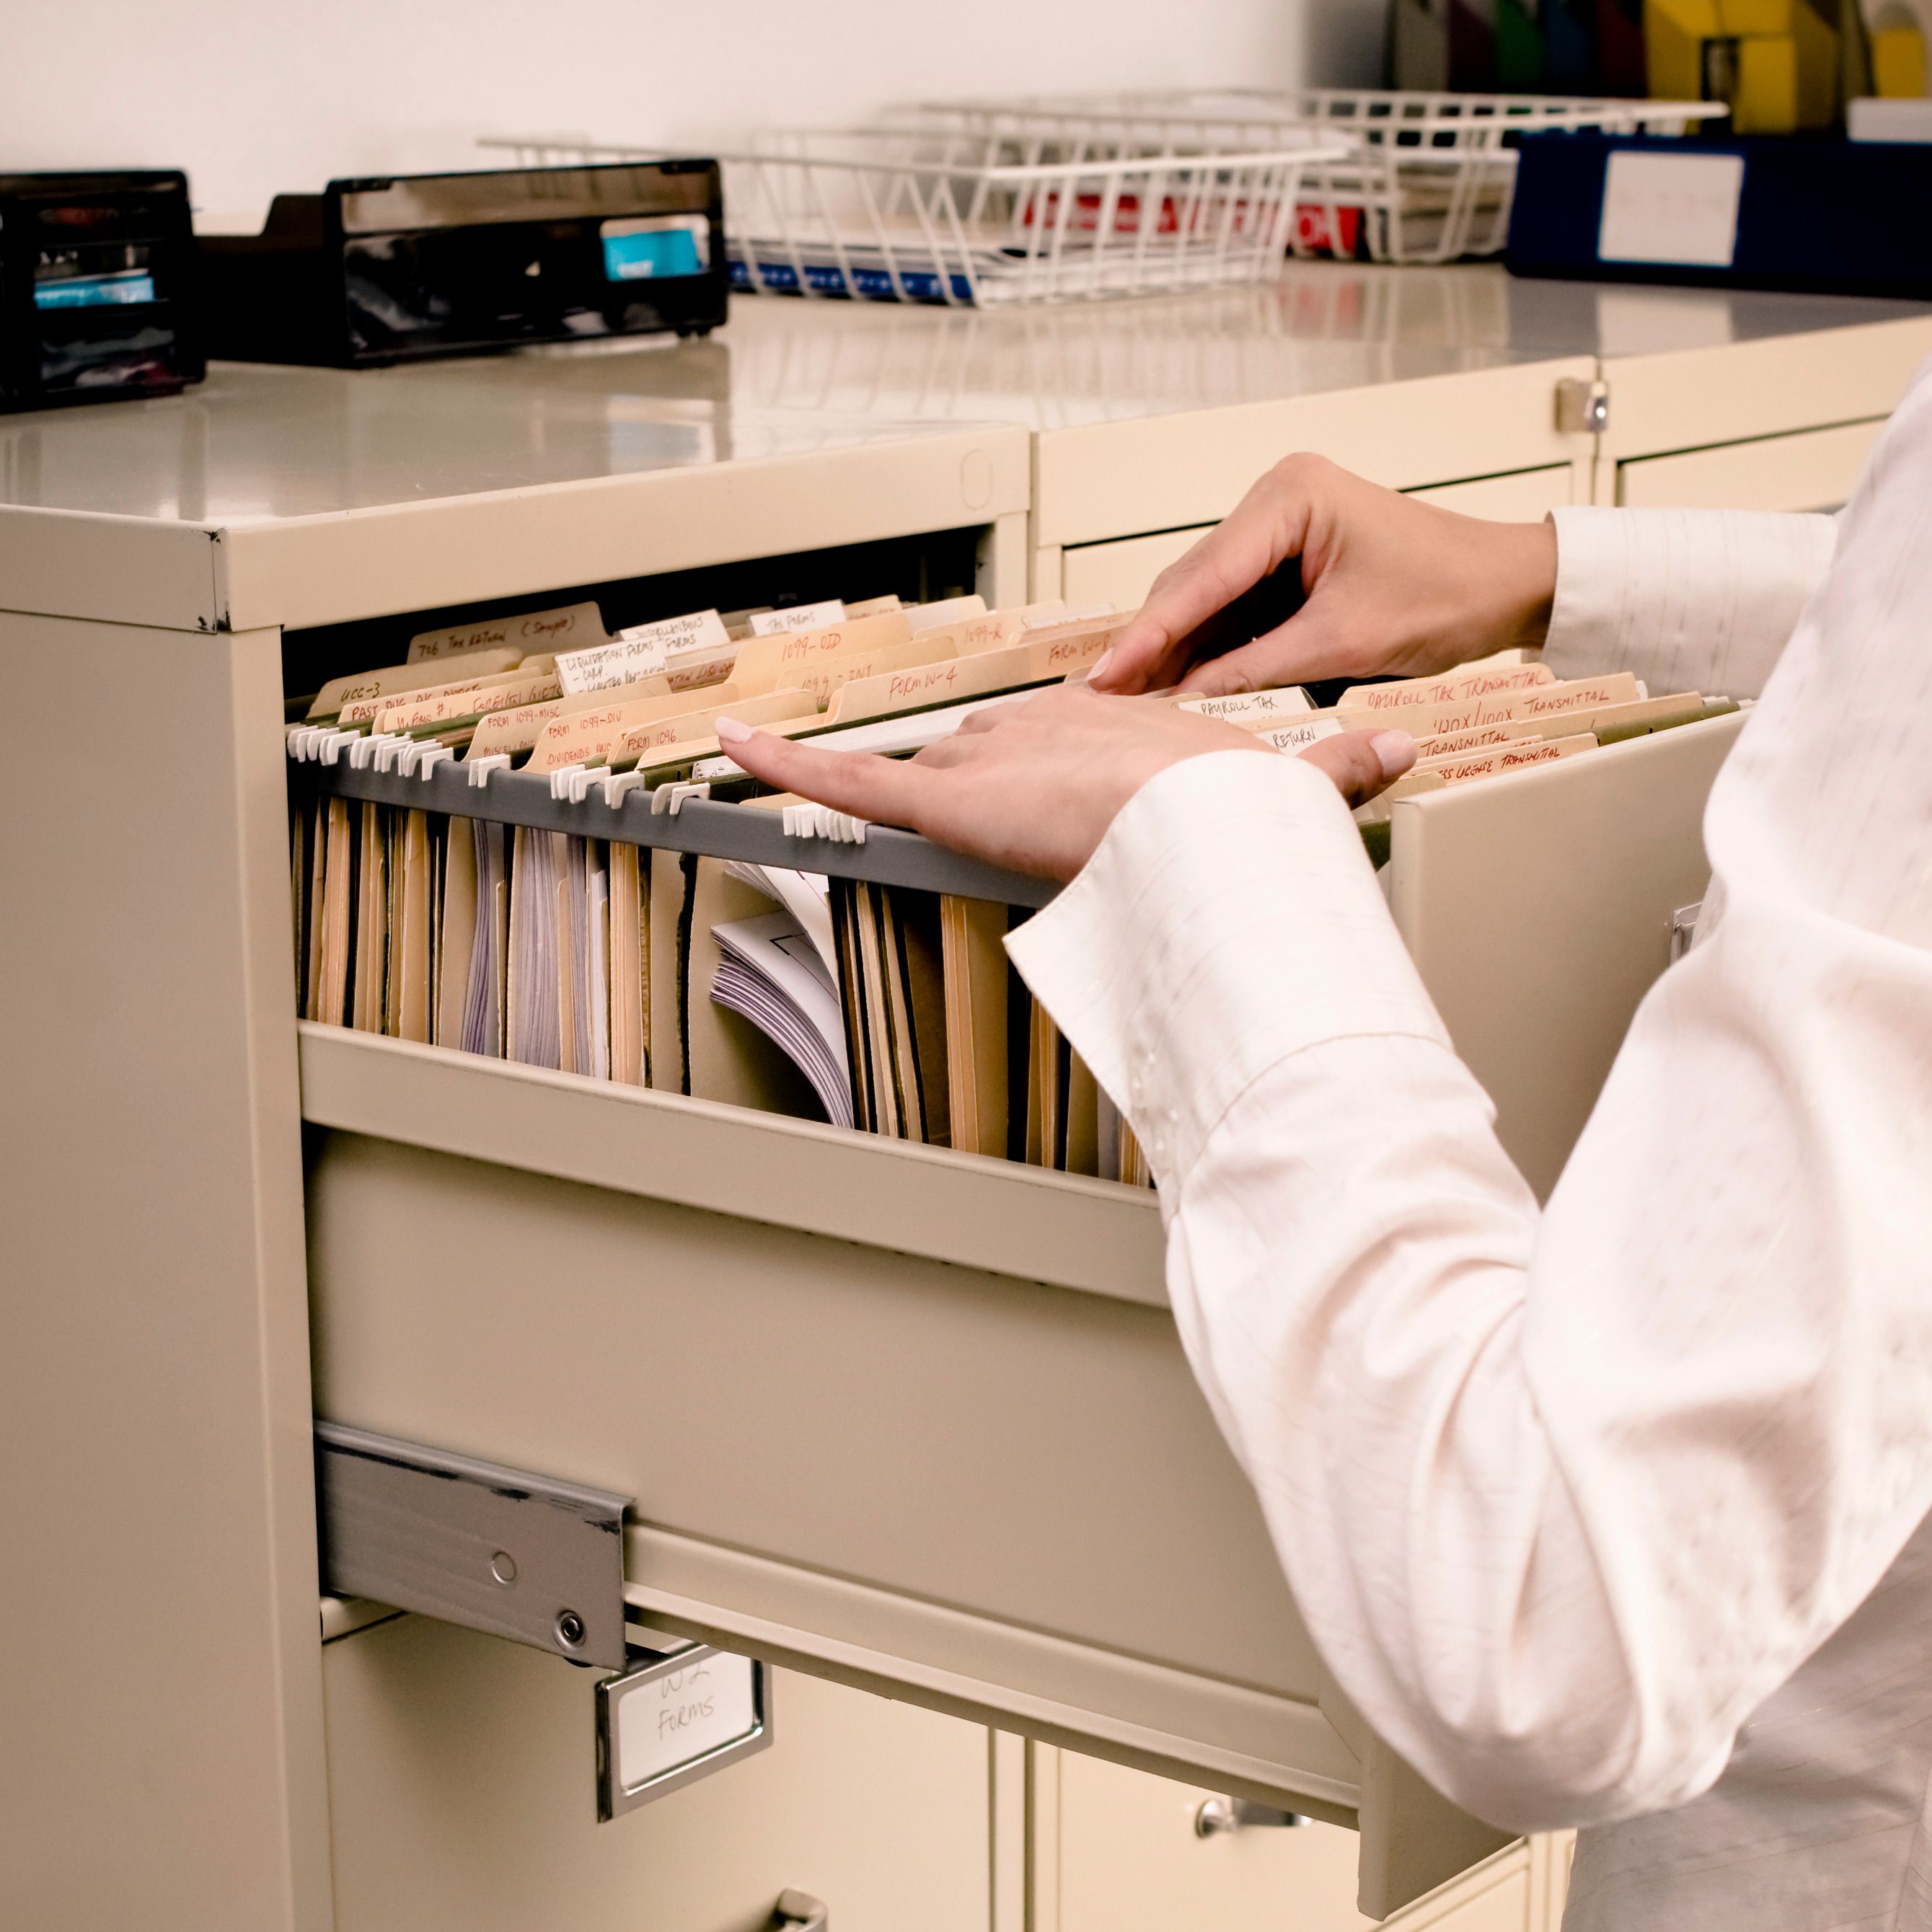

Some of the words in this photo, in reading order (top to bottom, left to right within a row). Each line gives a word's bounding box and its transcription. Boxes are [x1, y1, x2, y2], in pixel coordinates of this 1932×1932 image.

[1049, 644, 1077, 666] FORM
[340, 682, 380, 702] UCC-3
[889, 676, 921, 702] FORM
[925, 666, 957, 688] W-4
[1429, 685, 1455, 703] TAX
[352, 705, 378, 721] PAST
[1201, 700, 1250, 720] PAYROLL
[1253, 695, 1279, 710] TAX
[1523, 689, 1610, 714] TRANSMITTAL
[488, 716, 509, 728] FORM
[516, 706, 560, 723] 1099-MISC
[549, 725, 570, 738] FORM
[580, 710, 622, 729] 1099-DIV
[627, 734, 650, 753] FORM
[657, 728, 676, 744] 1096
[1272, 725, 1316, 750] RETURN
[1420, 730, 1509, 757] TRANSMITTAL
[547, 747, 590, 765] DIVIDENDS
[1500, 746, 1560, 768] TRANSMITTAL
[658, 1695, 715, 1740] FORMS
